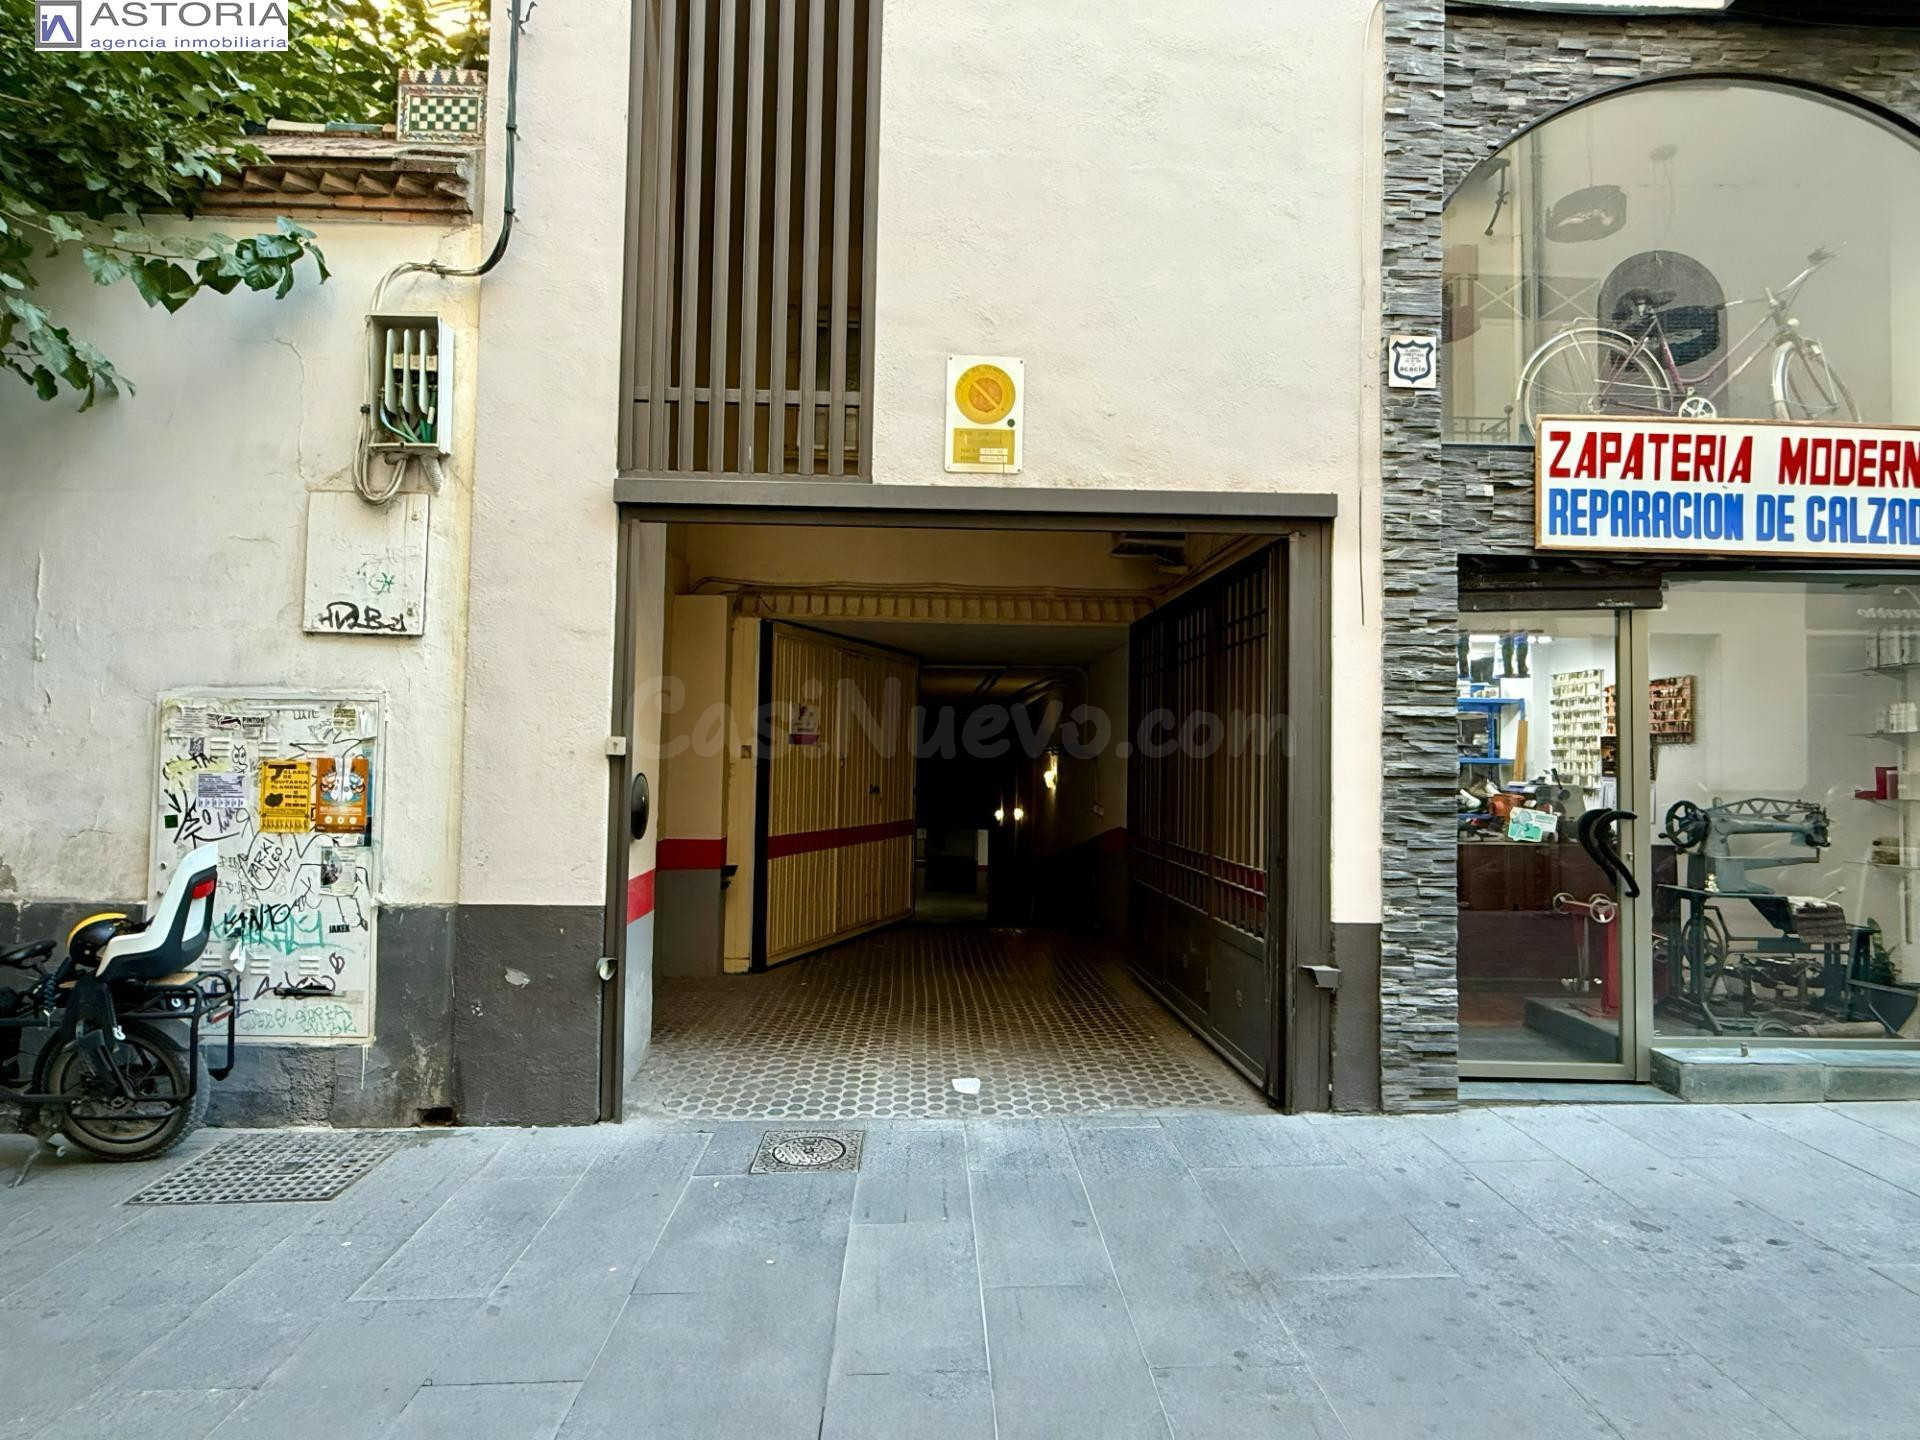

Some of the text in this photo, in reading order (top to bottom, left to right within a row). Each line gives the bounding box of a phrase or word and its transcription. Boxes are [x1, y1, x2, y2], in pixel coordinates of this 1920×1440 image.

[1548, 430, 1754, 485] ZAPATERIA
[1548, 487, 1745, 541] REPARACION
[1755, 493, 1796, 543] DE
[242, 716, 265, 724] PINTOR
